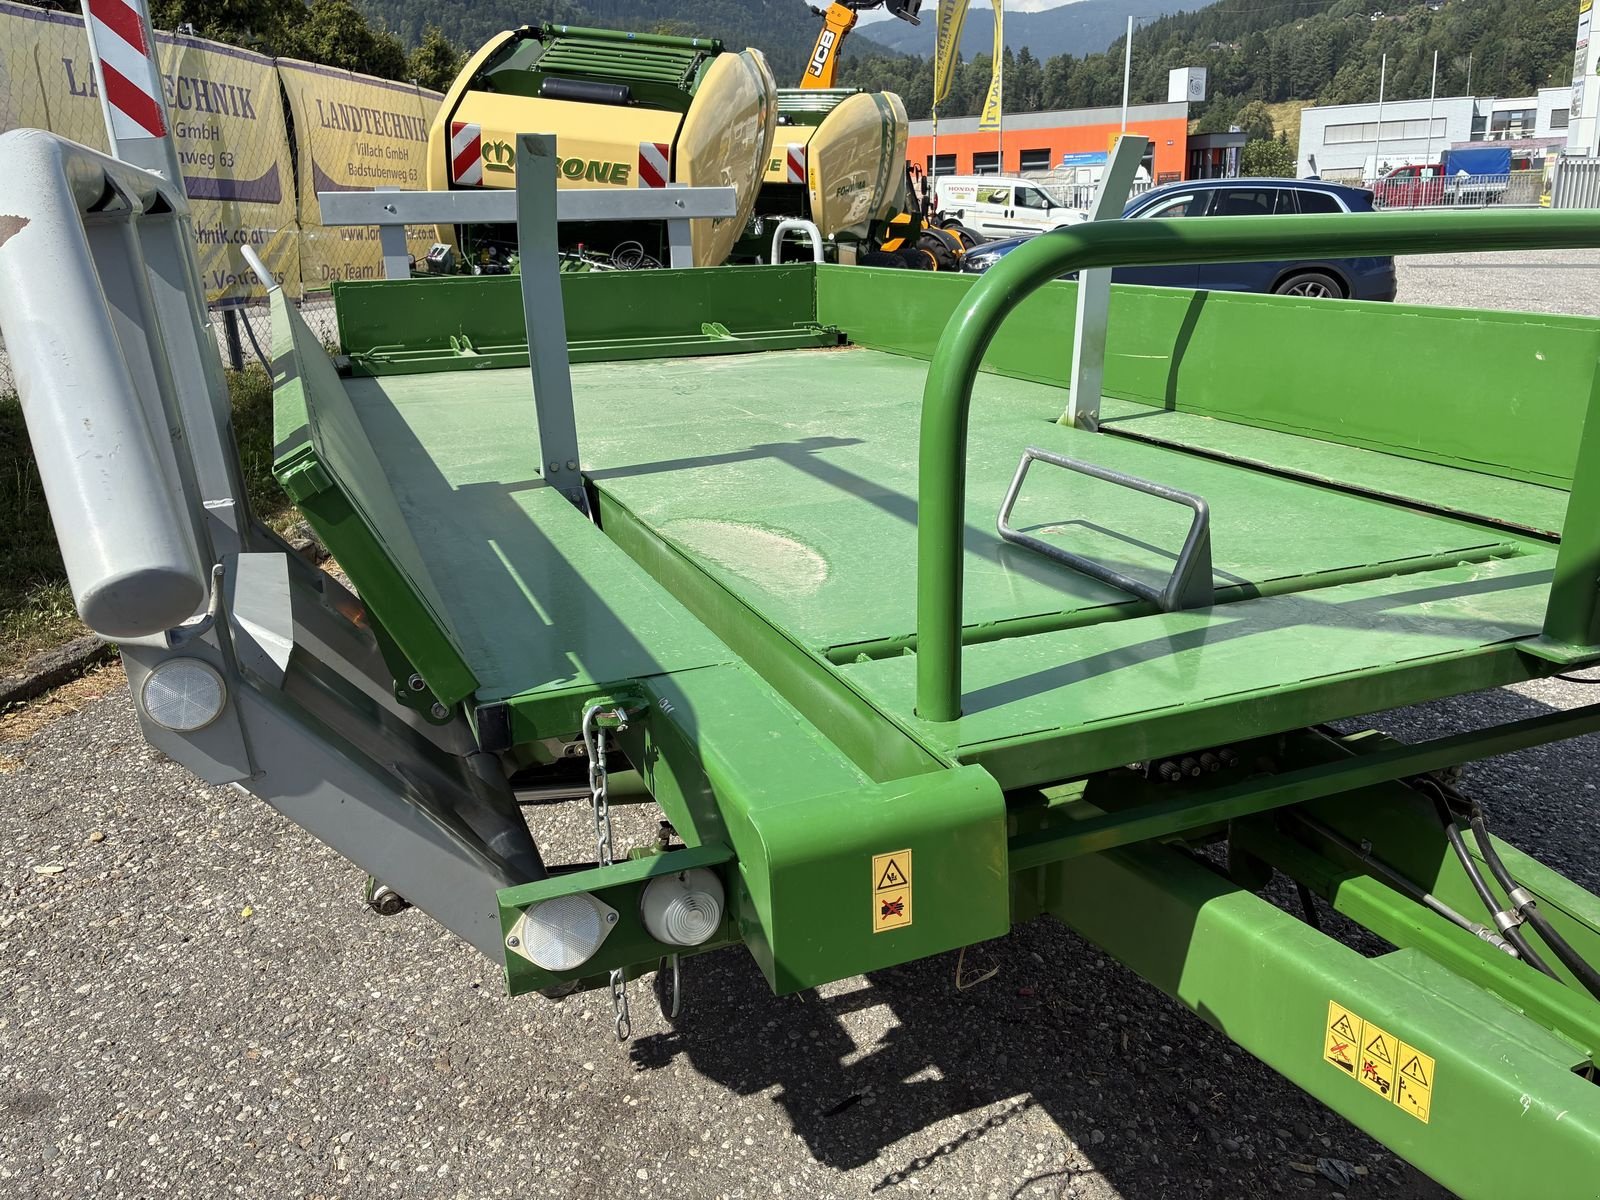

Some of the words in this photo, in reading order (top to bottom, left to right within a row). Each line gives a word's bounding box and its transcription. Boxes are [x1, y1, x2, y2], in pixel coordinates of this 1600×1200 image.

[812, 30, 835, 77] JCB
[316, 98, 428, 142] LANDTECHNIK
[175, 121, 220, 142] GmbH
[219, 151, 234, 168] 63
[355, 142, 384, 158] Villach
[385, 146, 409, 161] GmbH
[347, 162, 407, 183] Badstubenweg
[408, 168, 418, 181] 63
[321, 264, 341, 281] Das
[344, 262, 374, 280] Team
